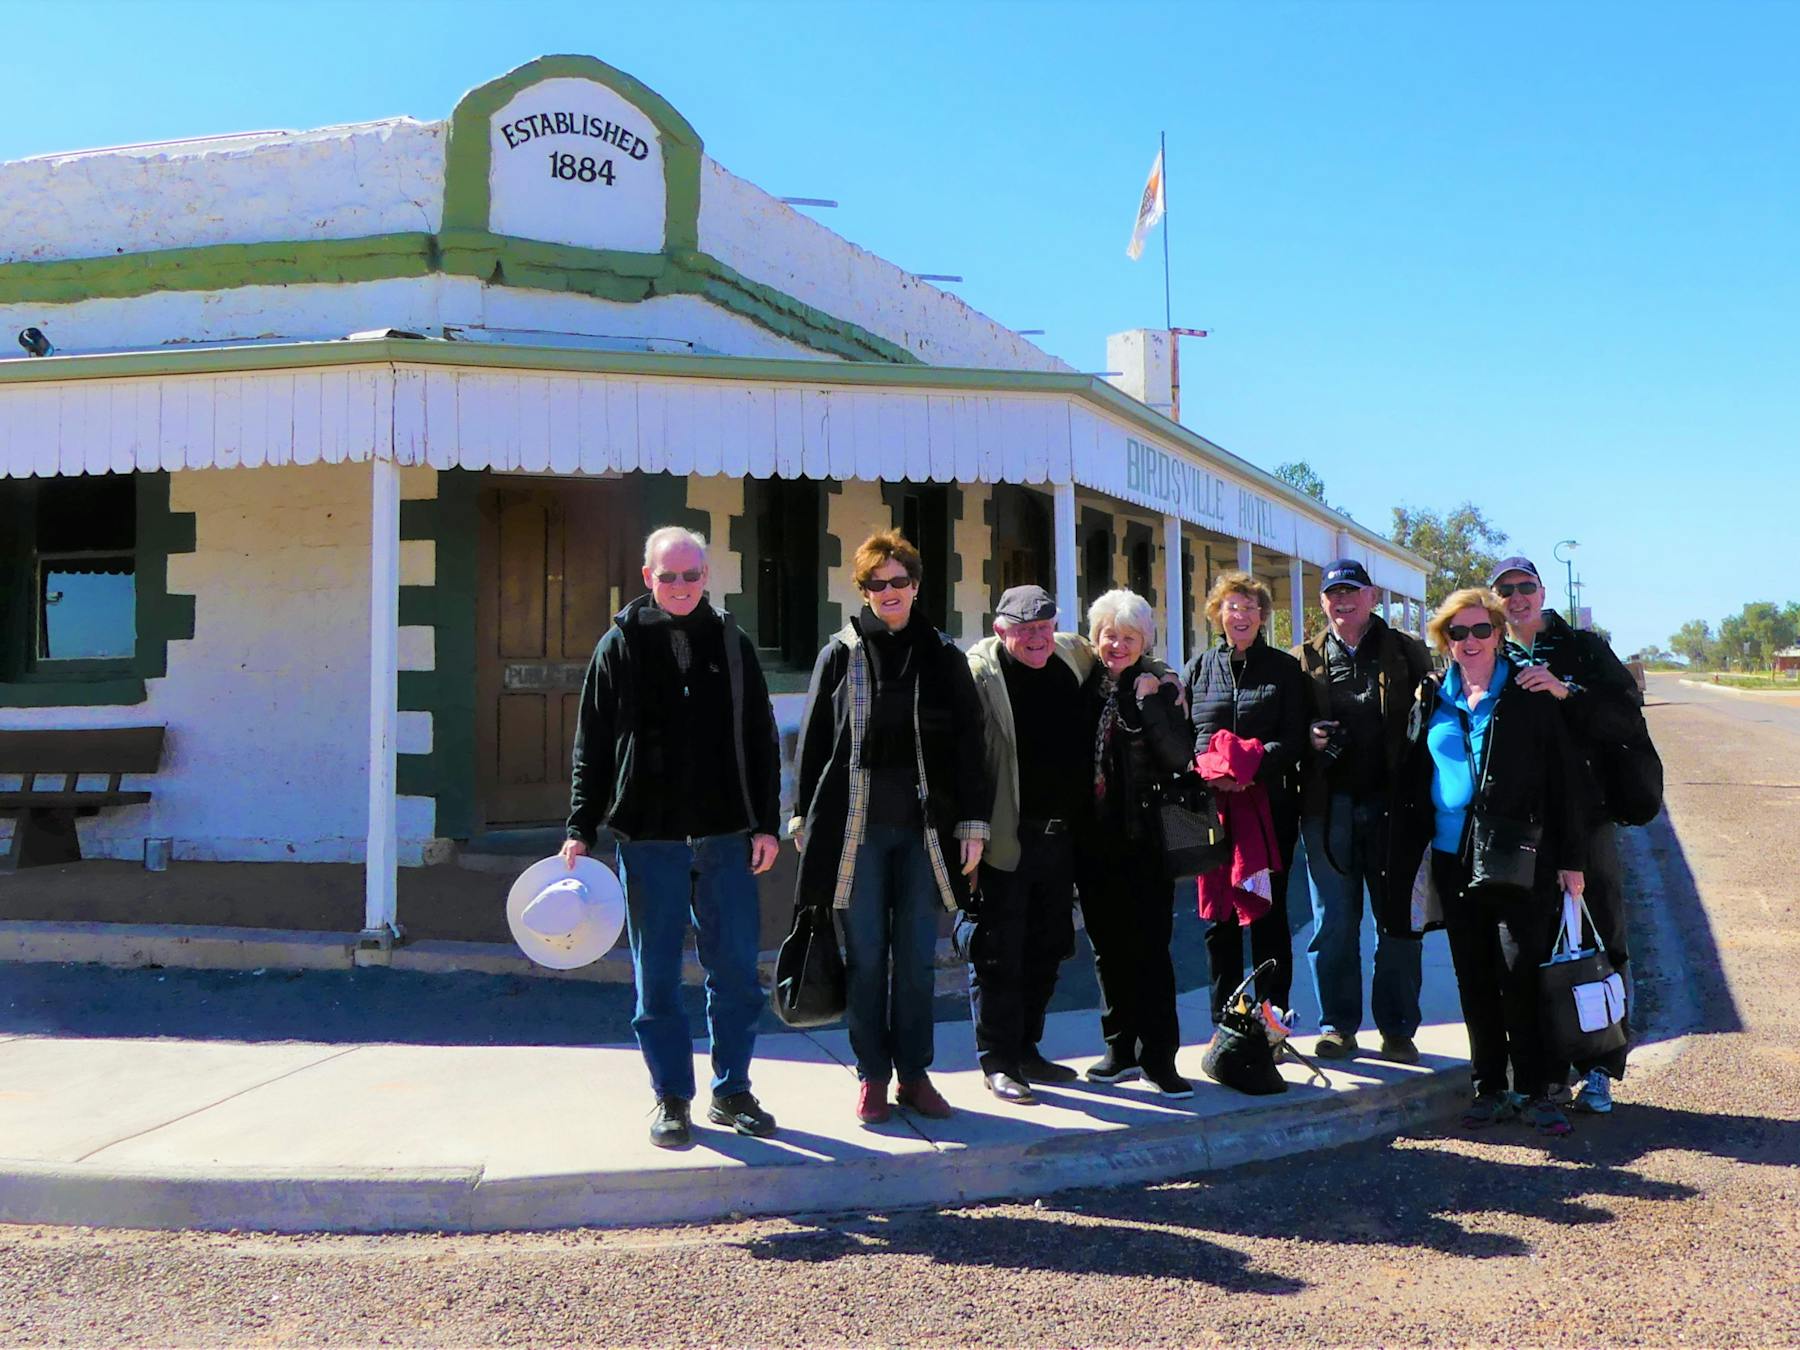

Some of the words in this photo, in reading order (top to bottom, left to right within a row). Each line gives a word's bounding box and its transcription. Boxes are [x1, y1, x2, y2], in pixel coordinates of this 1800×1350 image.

[501, 112, 649, 161] ESTABLISHED
[549, 151, 616, 186] 1884
[1126, 438, 1224, 521] BIRDSVILLE
[1239, 487, 1277, 540] HOTEL
